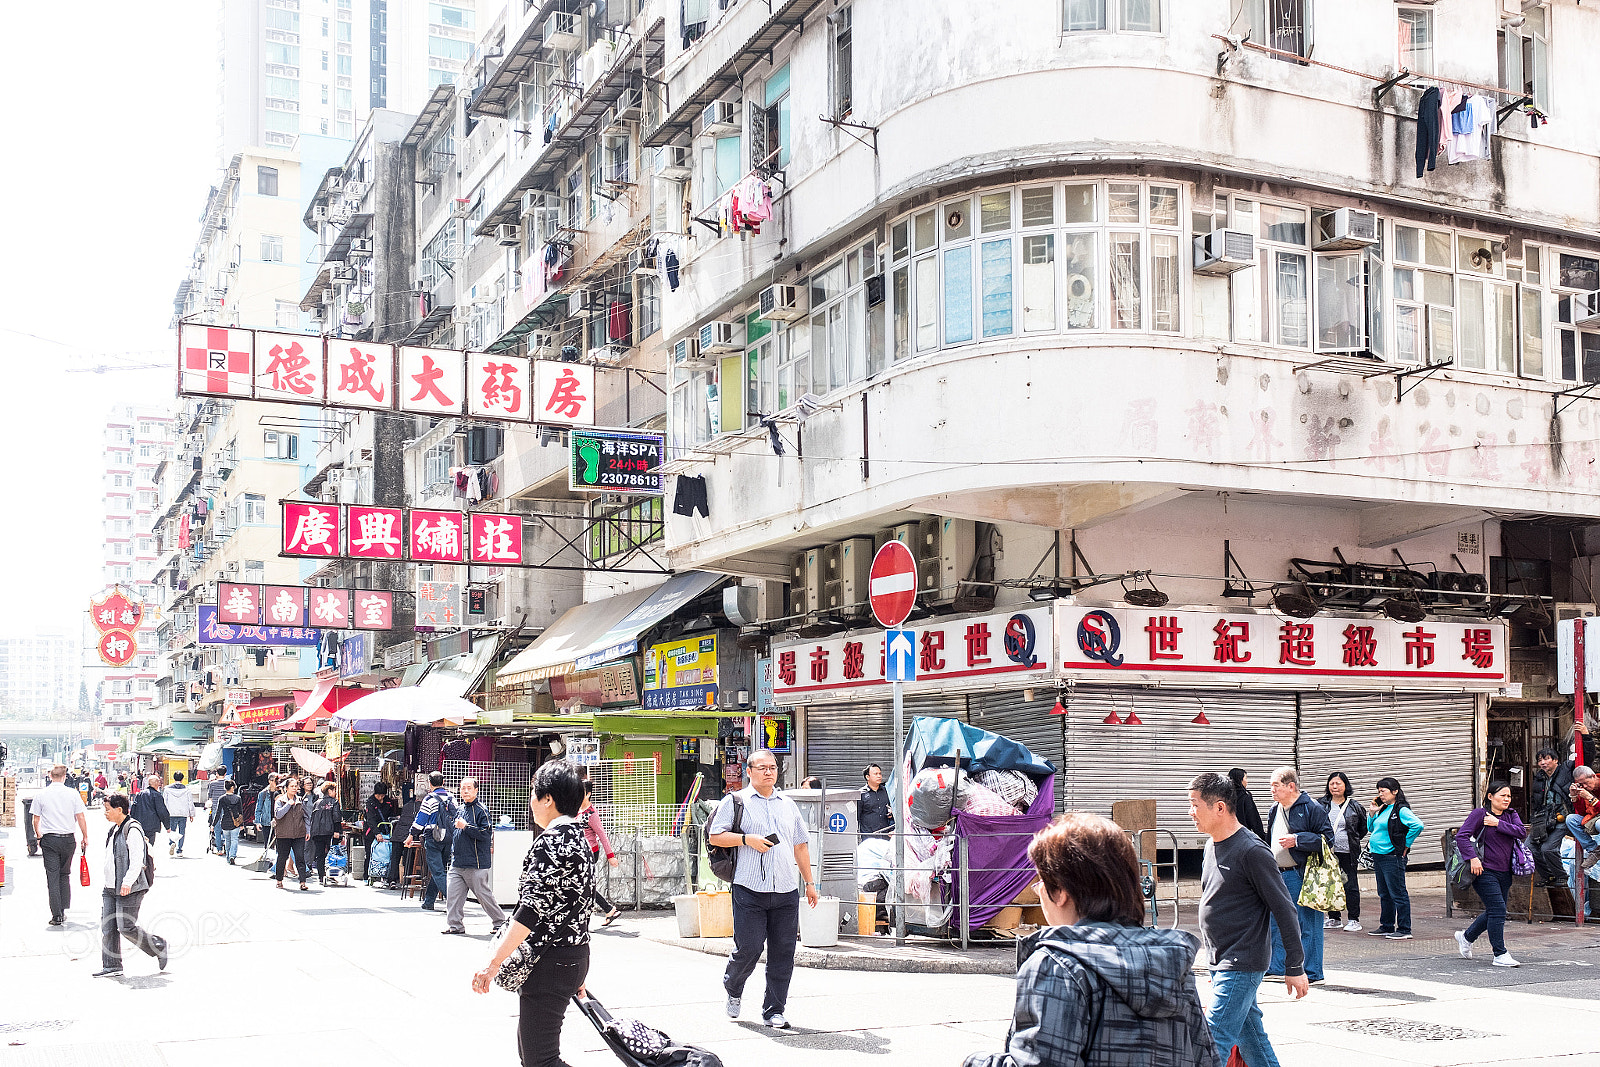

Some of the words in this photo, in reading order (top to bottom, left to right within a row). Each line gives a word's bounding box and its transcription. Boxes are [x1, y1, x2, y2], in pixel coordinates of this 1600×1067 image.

[609, 459, 648, 472] 24小時
[601, 473, 658, 486] 23078618
[286, 507, 519, 560] 廣興繡莊
[223, 587, 387, 626] 華南冰室
[106, 636, 129, 659] 押
[1144, 616, 1495, 669] 世紀超級市場
[680, 690, 689, 698] TAK
[691, 688, 703, 696] SING
